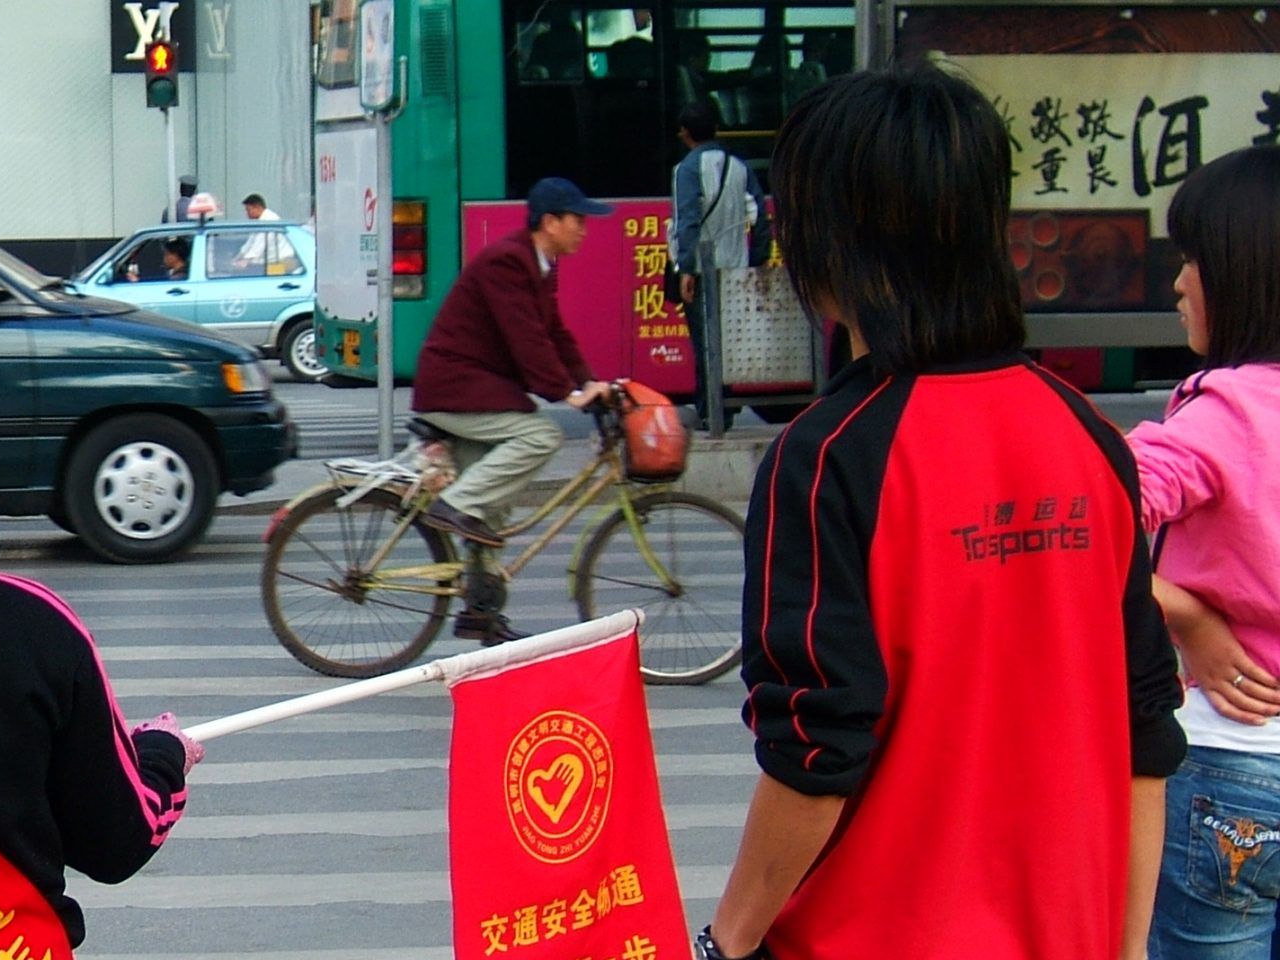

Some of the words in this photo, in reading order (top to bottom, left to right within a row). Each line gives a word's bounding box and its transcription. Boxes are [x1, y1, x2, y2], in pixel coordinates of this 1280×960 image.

[480, 864, 645, 957] 交通安全畅通
